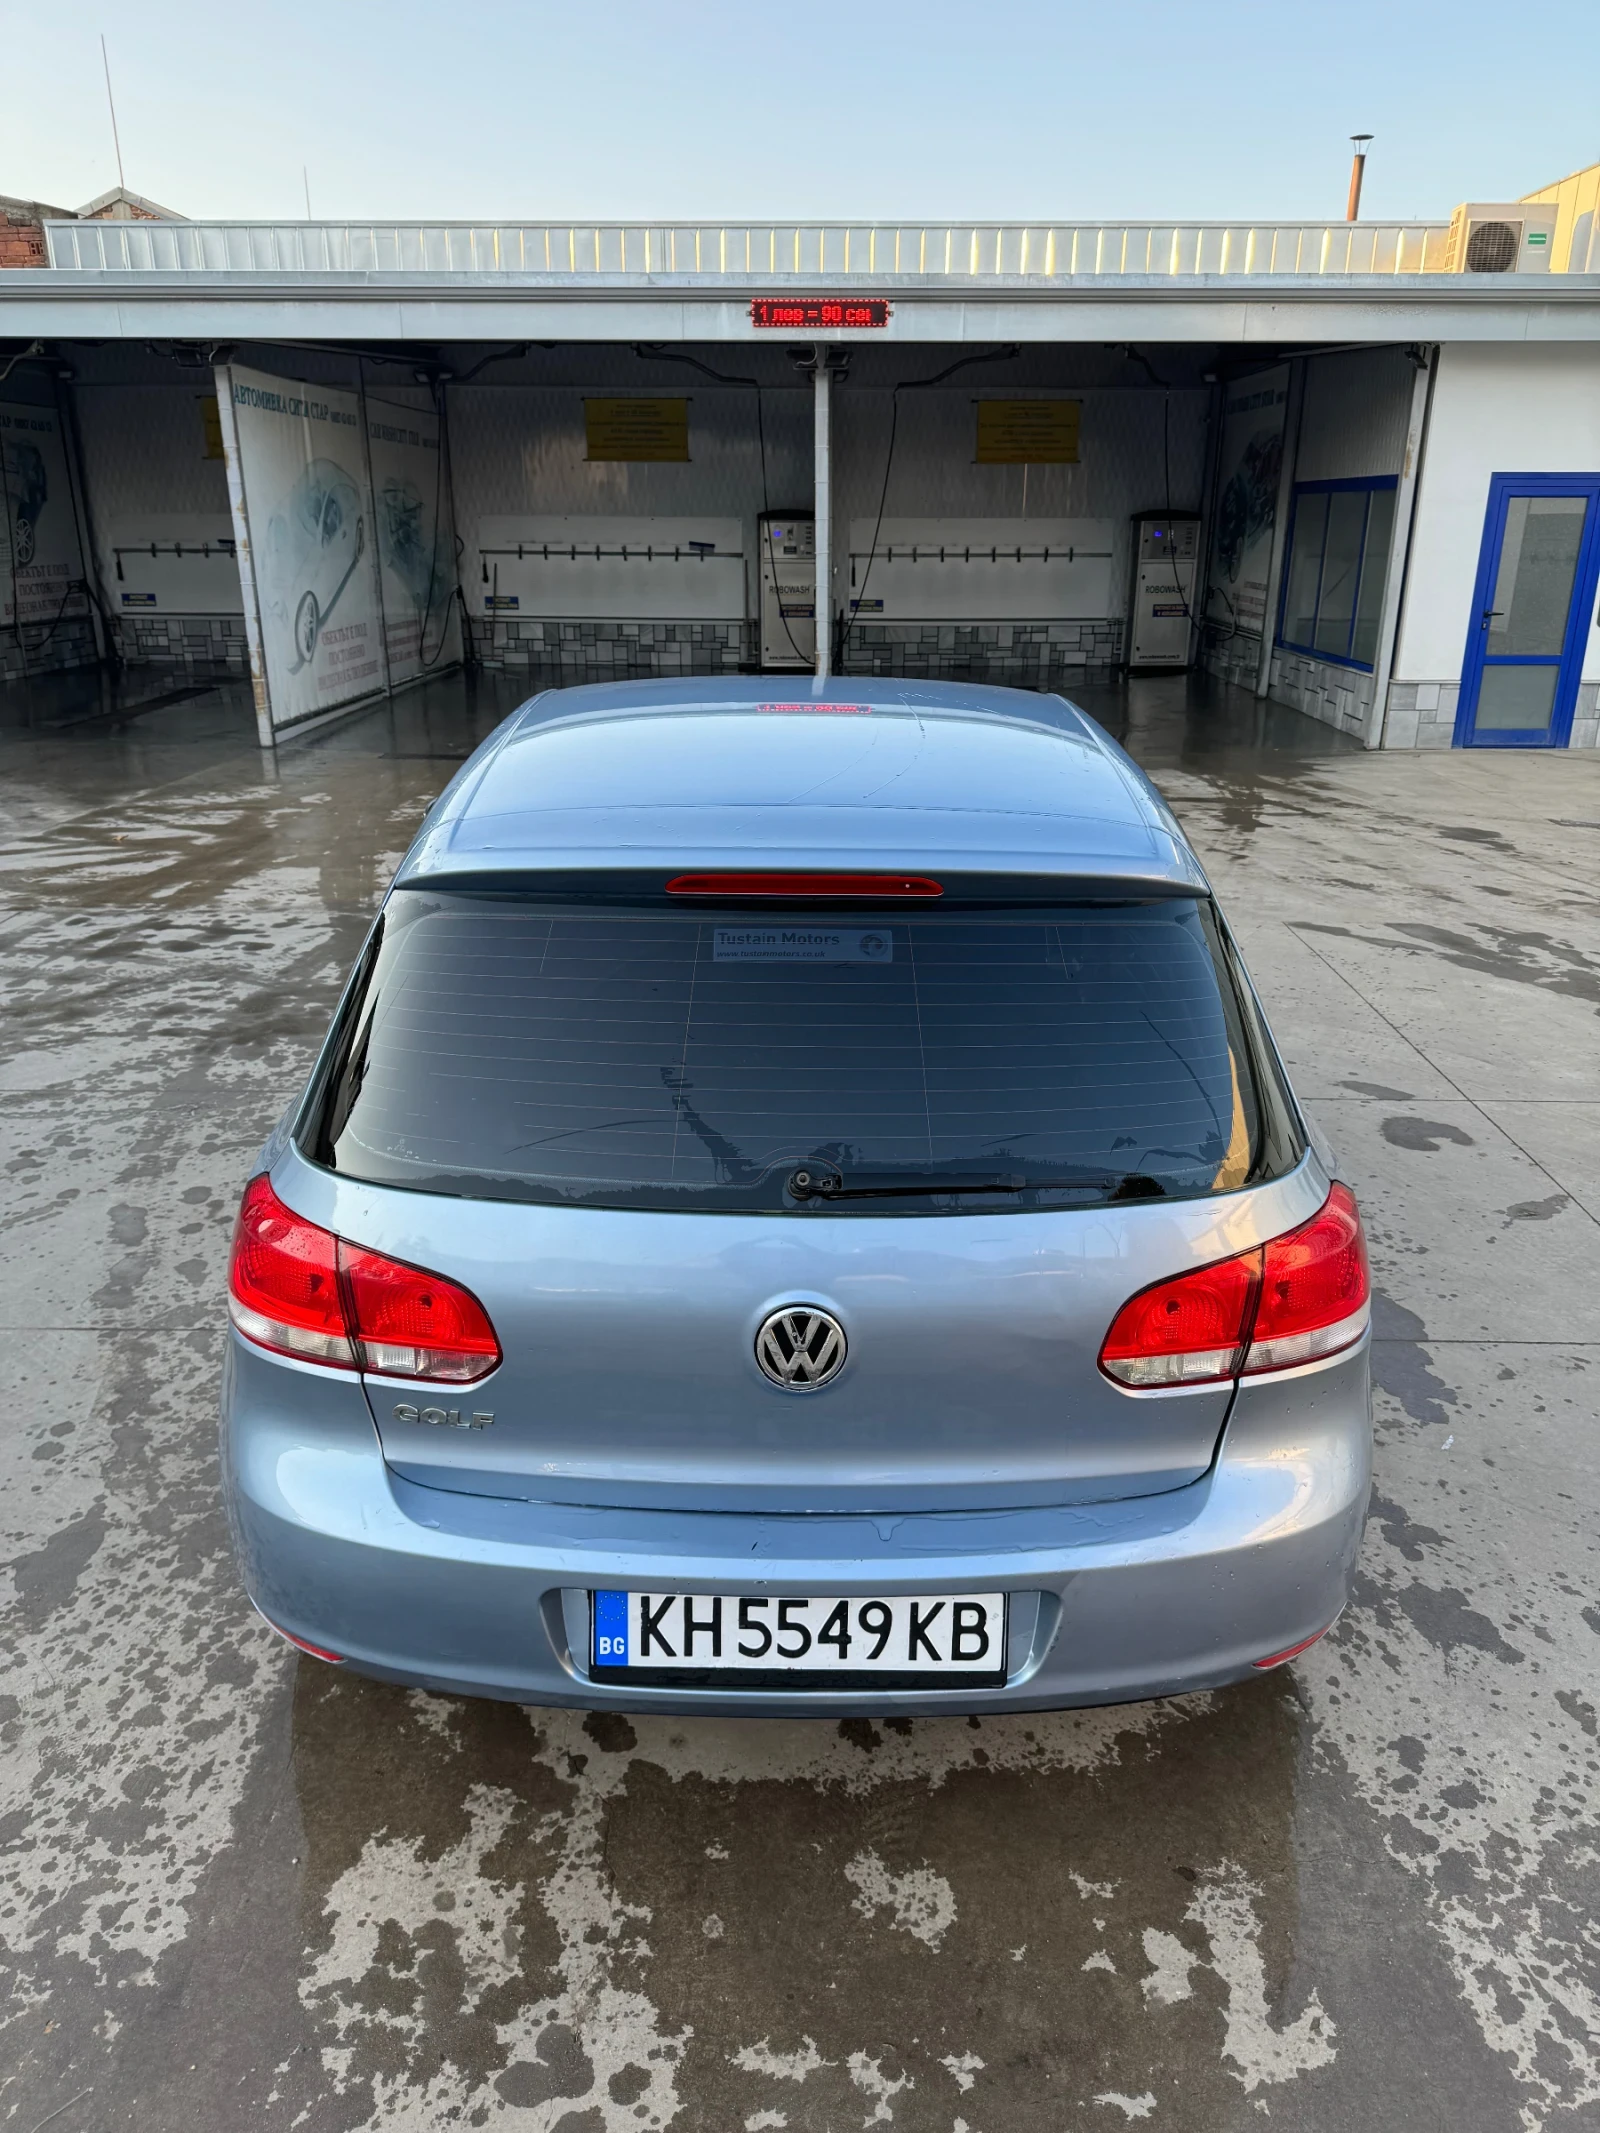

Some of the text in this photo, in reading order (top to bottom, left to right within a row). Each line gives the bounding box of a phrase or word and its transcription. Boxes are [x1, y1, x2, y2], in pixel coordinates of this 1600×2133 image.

[760, 305, 767, 321] 1
[772, 308, 804, 321] лев
[822, 305, 842, 321] 90
[234, 383, 288, 414] АВТОМИВКА
[718, 932, 840, 946] Tustain Motors
[757, 1308, 846, 1388] VW
[392, 1403, 495, 1431] GOLF
[599, 1636, 625, 1655] BG
